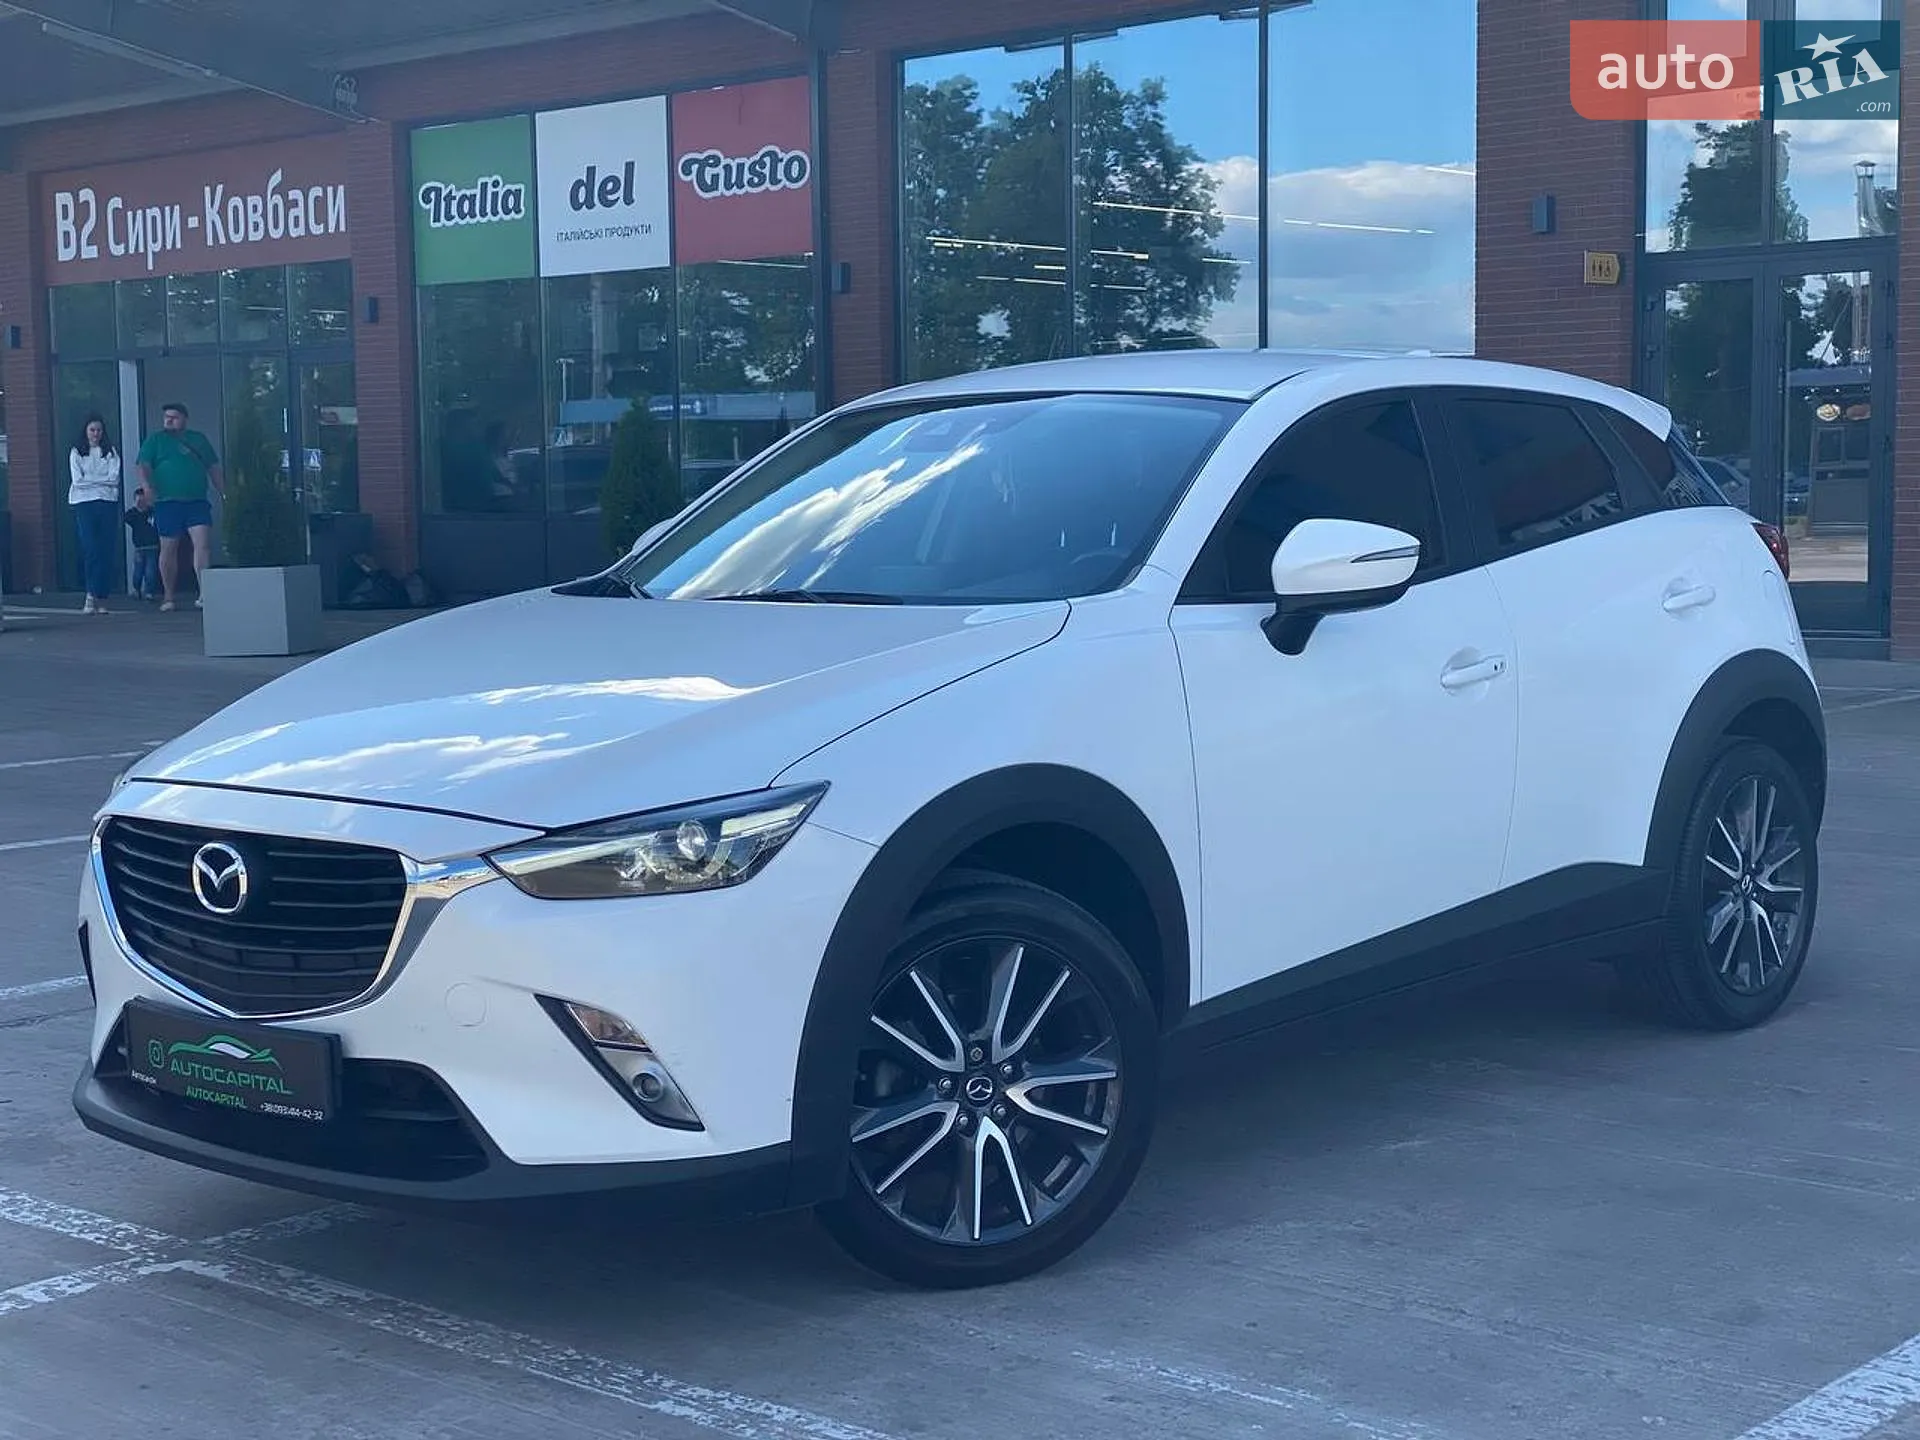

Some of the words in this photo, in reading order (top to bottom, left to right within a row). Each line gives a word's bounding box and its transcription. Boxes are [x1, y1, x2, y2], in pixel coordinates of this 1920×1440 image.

[420, 174, 525, 229] Italia
[569, 161, 635, 212] del
[679, 144, 811, 200] Gusto
[604, 223, 652, 238] ПРОДУКТИ
[170, 1058, 294, 1095] AUTOCAPITAL
[186, 1085, 248, 1109] AUTOCAPITAL
